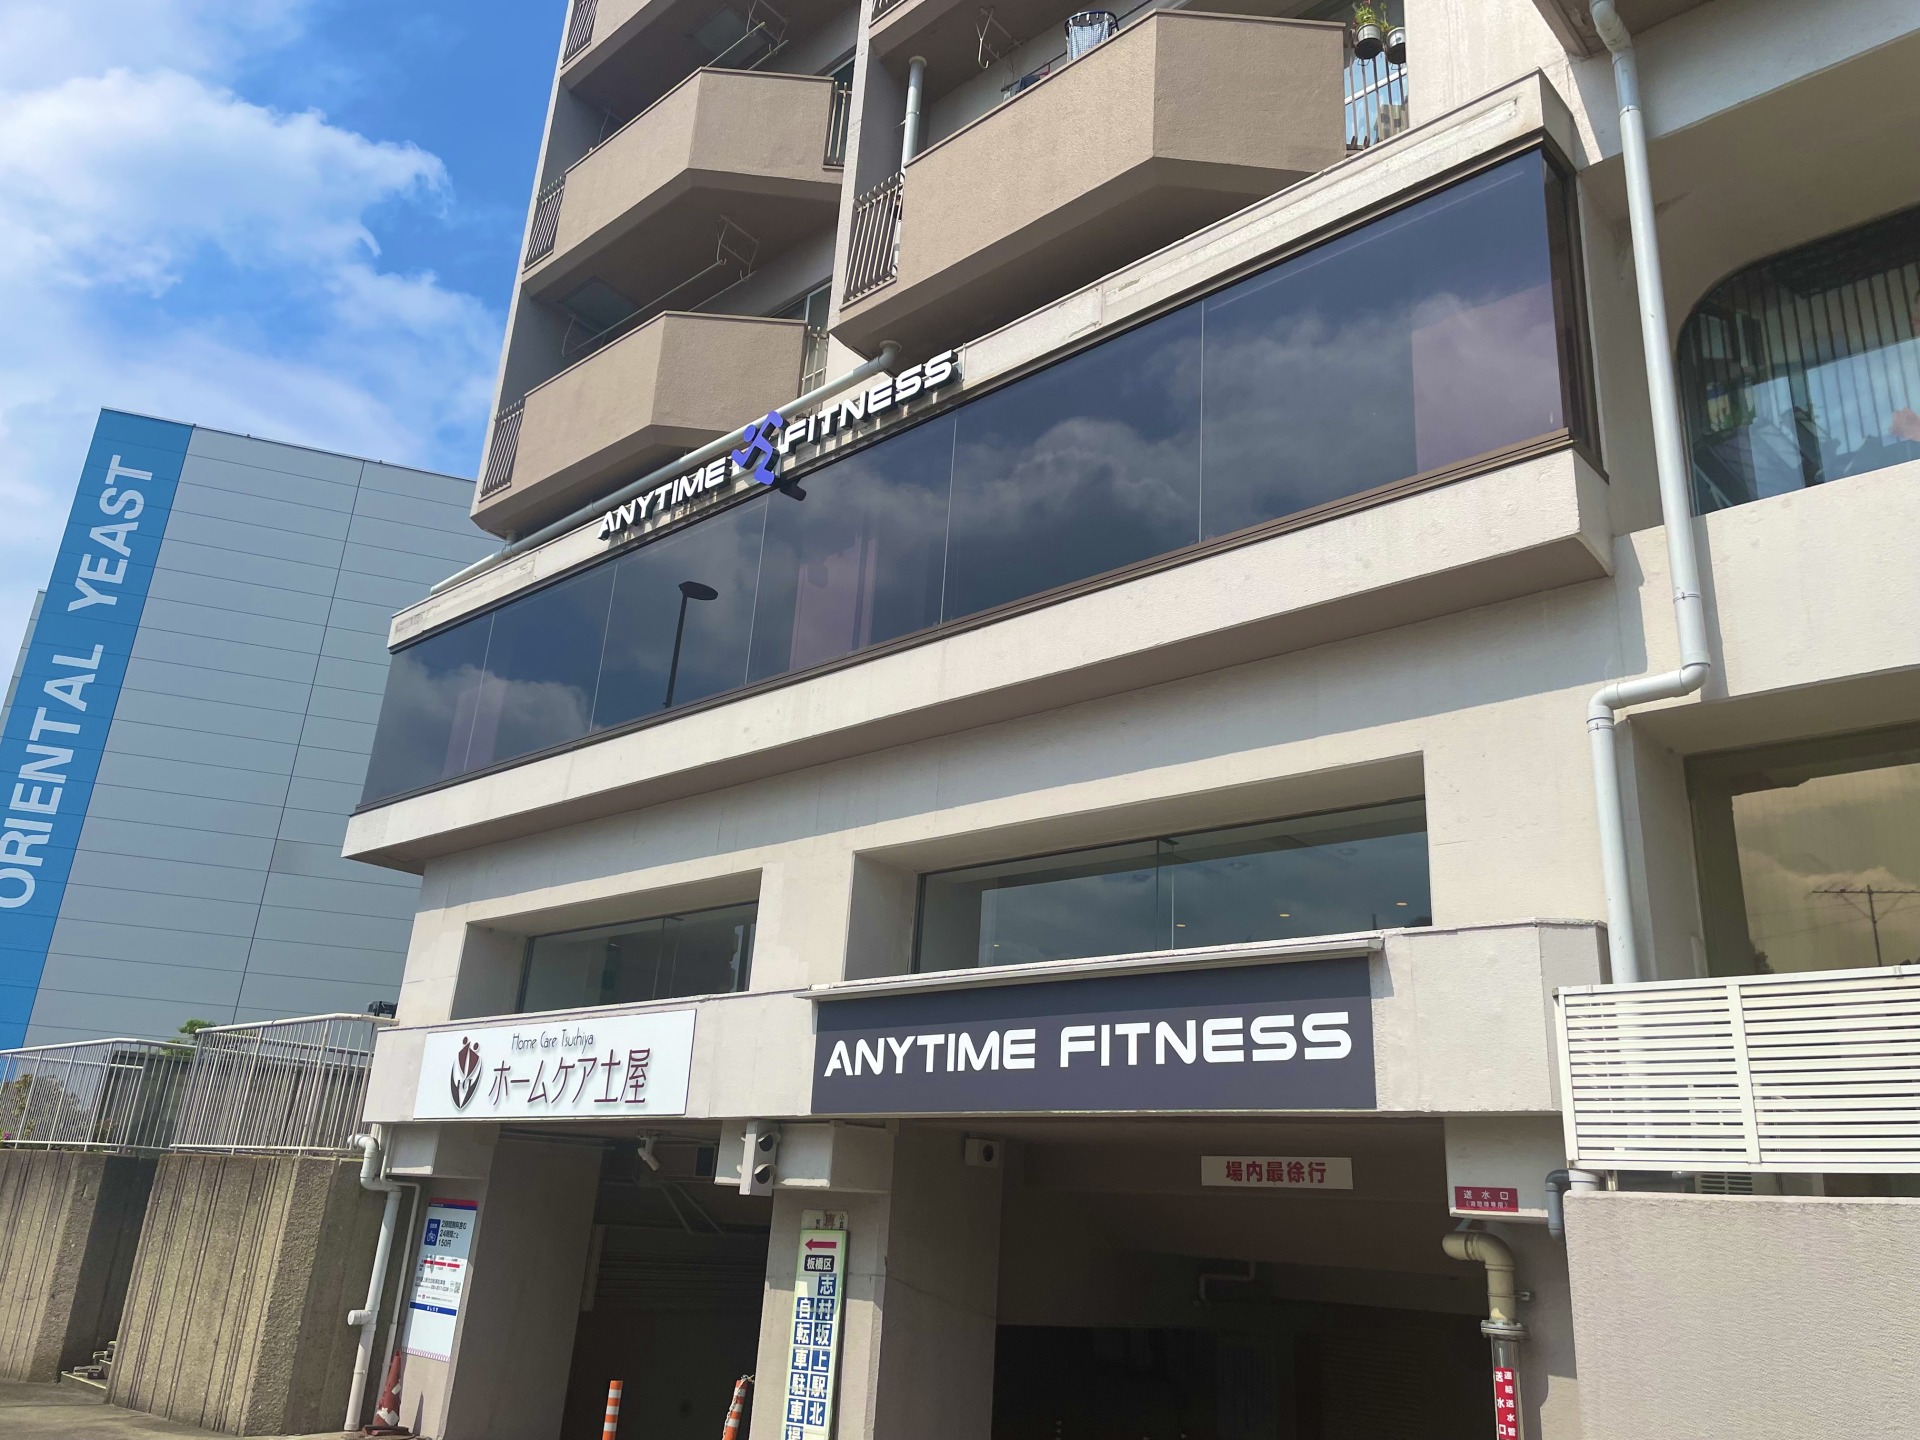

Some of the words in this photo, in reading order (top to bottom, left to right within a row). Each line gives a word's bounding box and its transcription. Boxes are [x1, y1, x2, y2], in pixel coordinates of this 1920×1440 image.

[597, 456, 730, 540] ANYTIME
[779, 349, 959, 456] FITNESS
[0, 643, 104, 909] ORIENTAL
[67, 453, 154, 613] YEAST
[511, 1032, 537, 1051] Home
[540, 1030, 557, 1048] Care
[561, 1027, 594, 1054] Tsuchiya
[823, 1027, 1036, 1078] ANYTIME
[1060, 1011, 1352, 1069] FITNESS
[488, 1047, 651, 1107] ホームケア土屋
[1225, 1160, 1327, 1184] 場内最徐行
[807, 1256, 832, 1271] 板橋区
[808, 1275, 836, 1425] 志村坂上駅北
